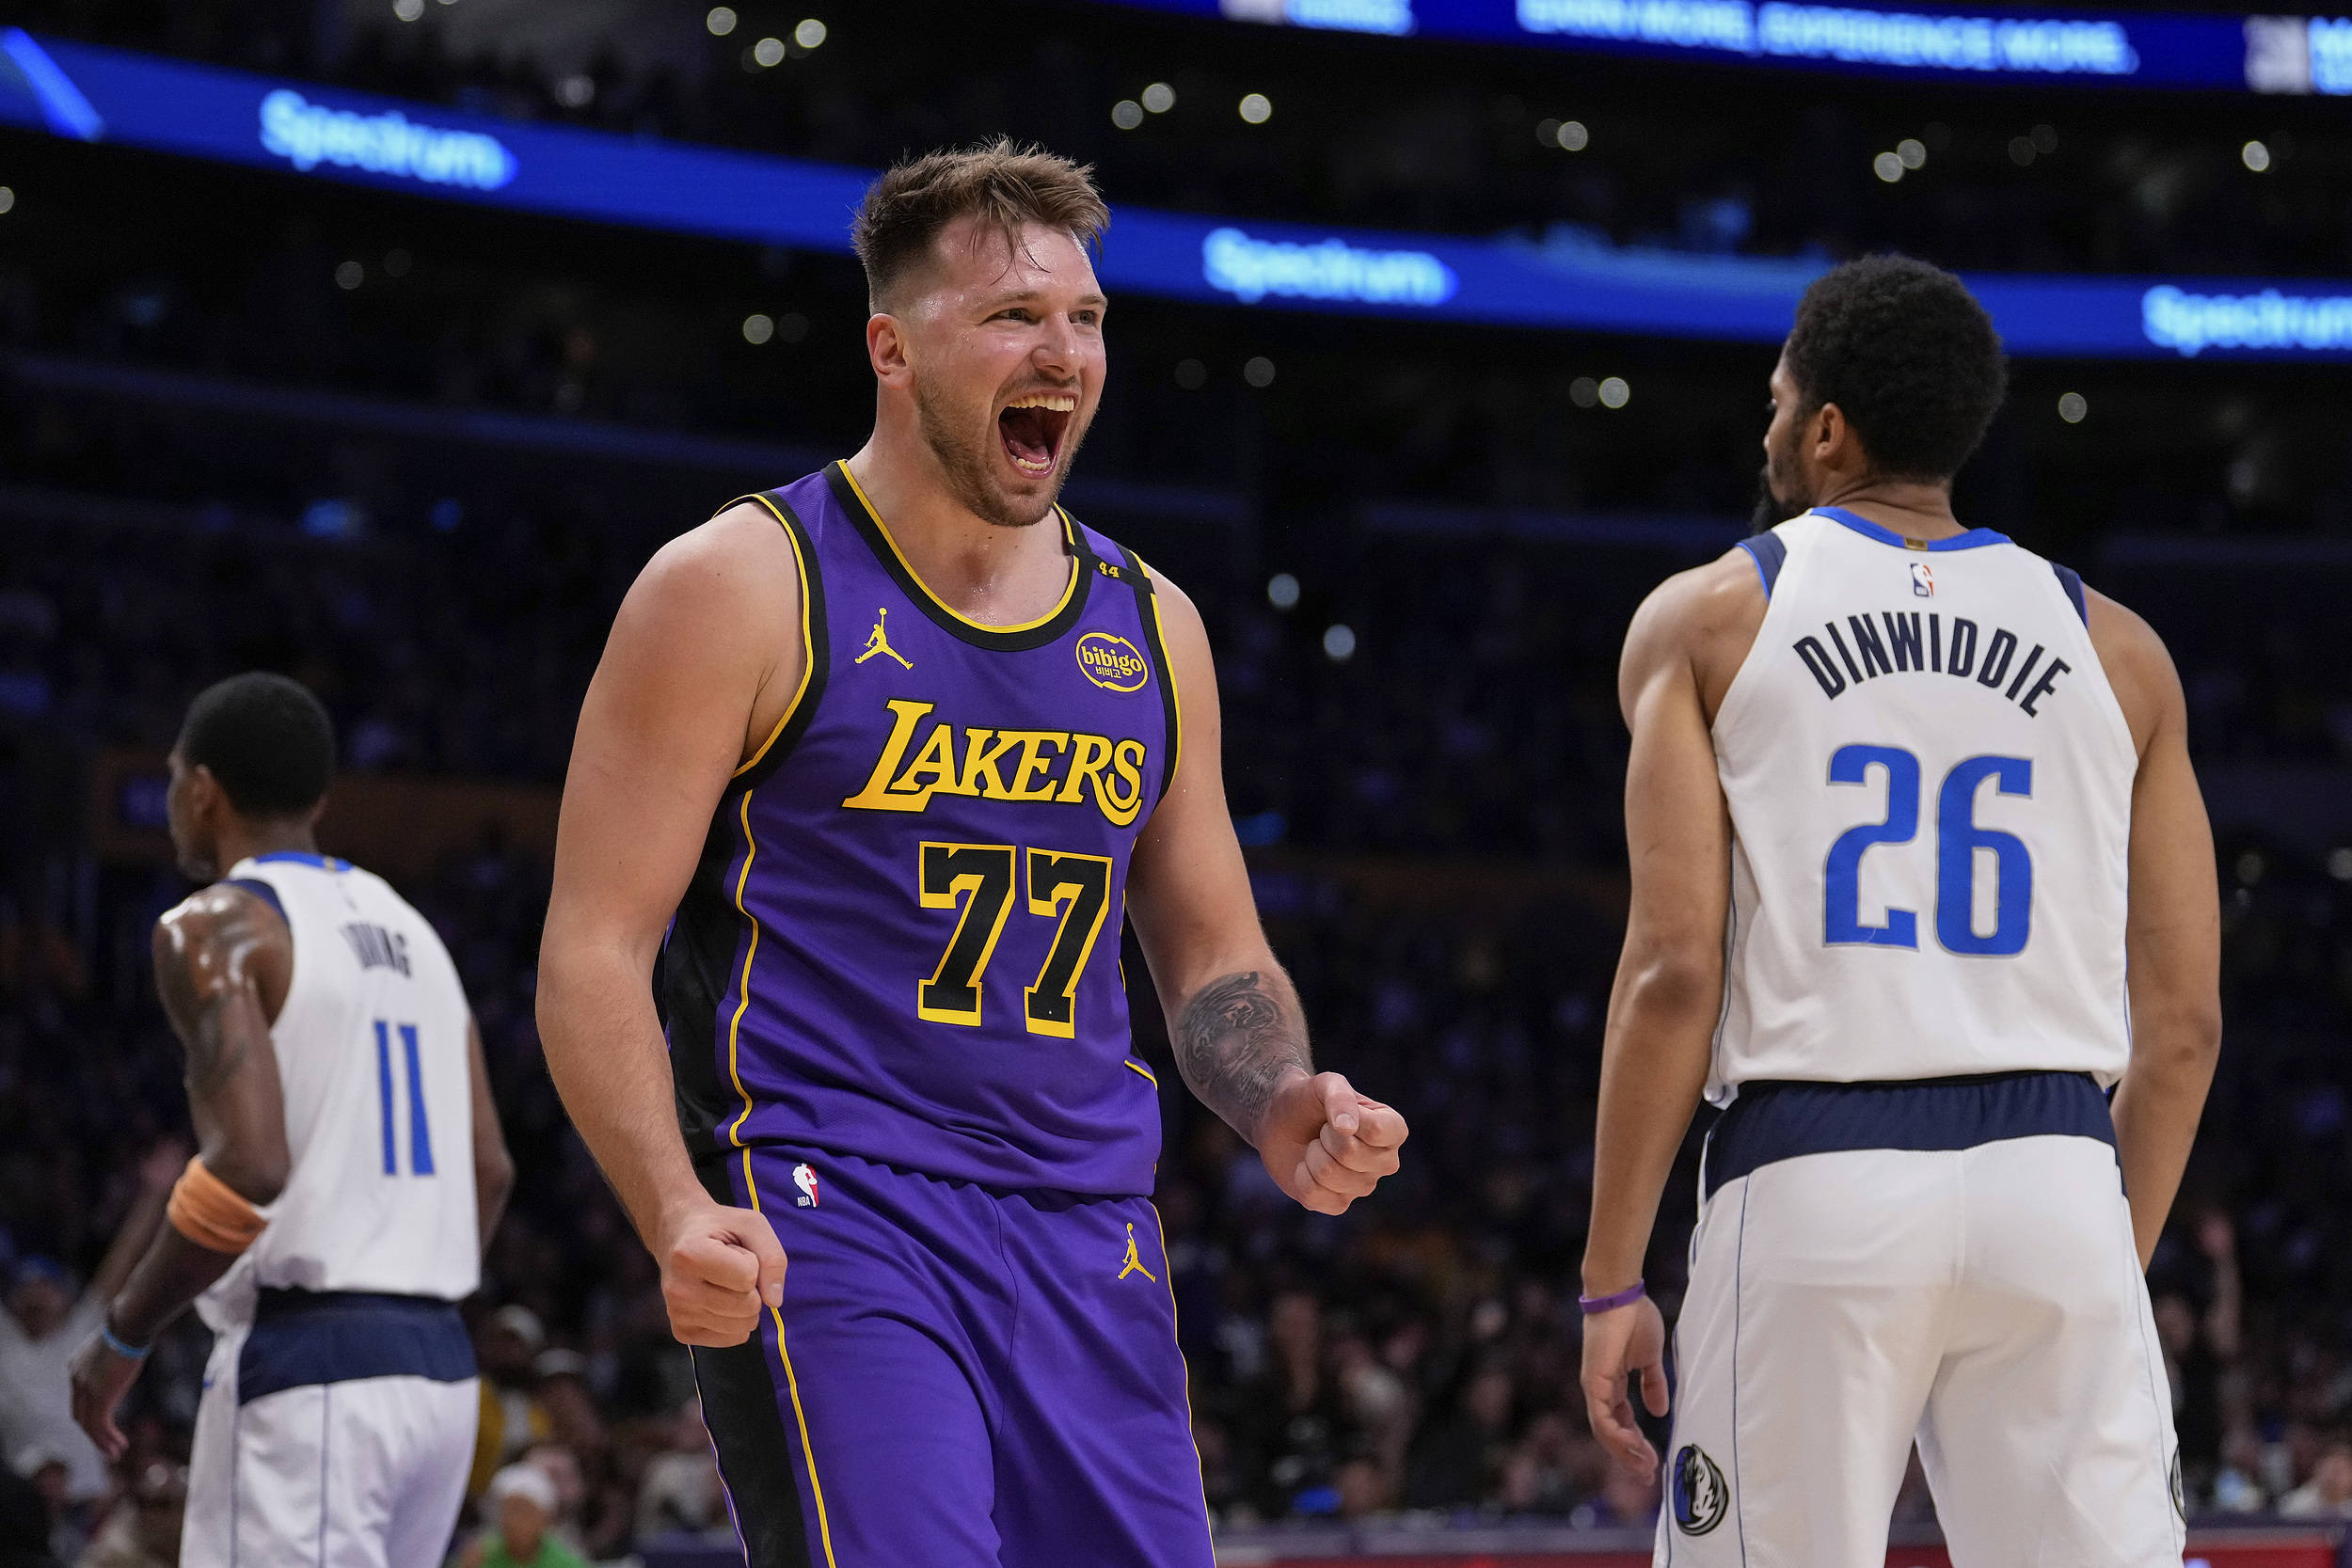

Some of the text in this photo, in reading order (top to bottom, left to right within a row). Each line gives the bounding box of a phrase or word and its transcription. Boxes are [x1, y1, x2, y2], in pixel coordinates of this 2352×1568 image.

[1758, 2, 1994, 71] EXPERIENCE
[262, 89, 510, 189] Spectrum
[1204, 228, 1450, 304] Spectrum
[1099, 562, 1120, 578] 44
[1081, 646, 1142, 676] bibigo
[1095, 666, 1122, 679] 비비고
[1792, 611, 2072, 718] DINWIDDIE
[841, 698, 1147, 827] LAKERS
[1822, 741, 2034, 958] 26
[918, 841, 1113, 1038] 77
[373, 1020, 436, 1176] 11
[797, 1196, 811, 1208] NBA
